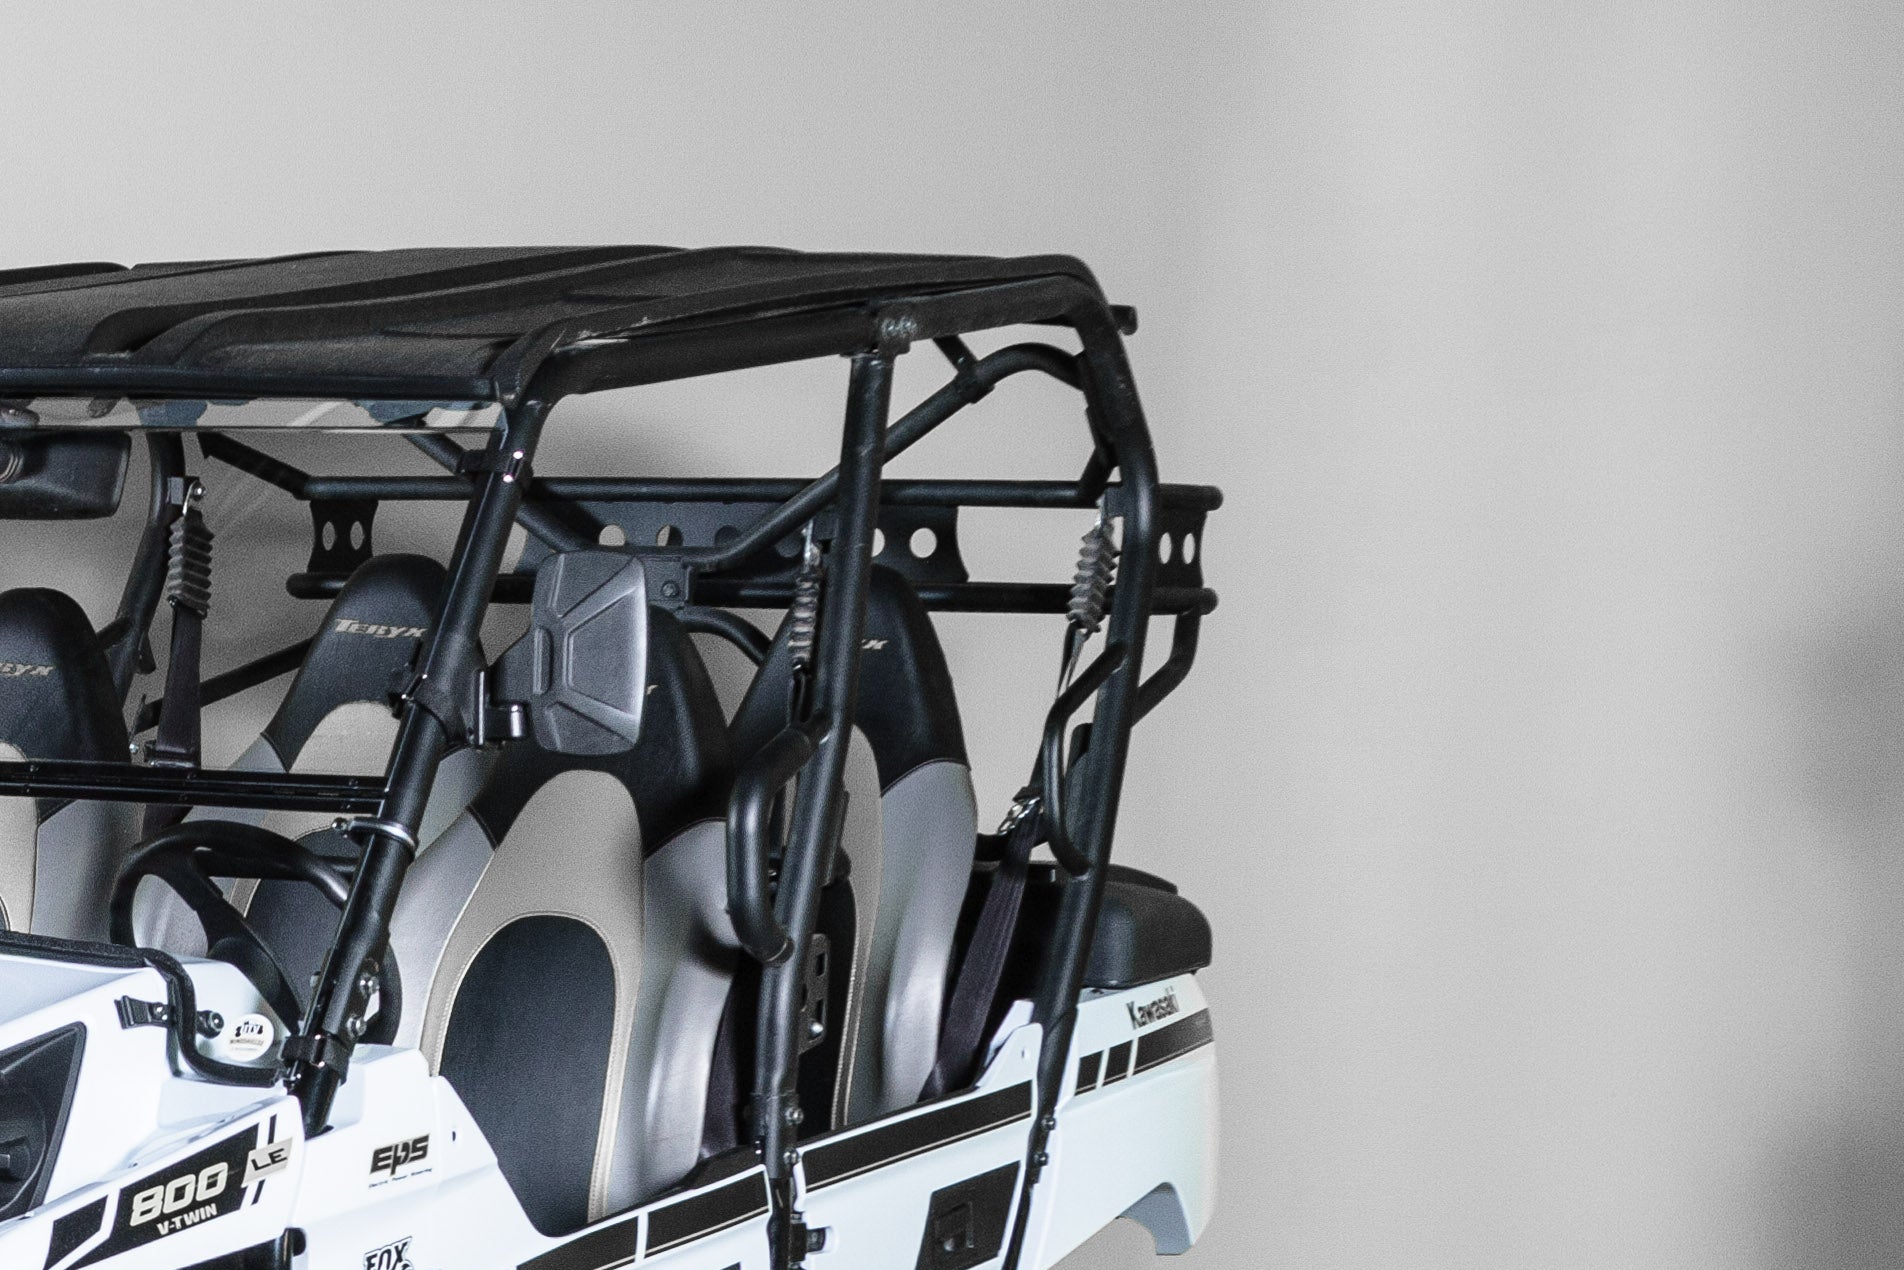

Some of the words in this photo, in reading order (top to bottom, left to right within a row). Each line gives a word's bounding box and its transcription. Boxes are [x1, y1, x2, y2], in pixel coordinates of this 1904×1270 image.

[1125, 985, 1180, 1030] Kawasaki
[369, 1133, 430, 1177] EPS
[129, 1161, 229, 1228] 800
[251, 1147, 289, 1172] LE
[156, 1202, 219, 1236] V-TWIN
